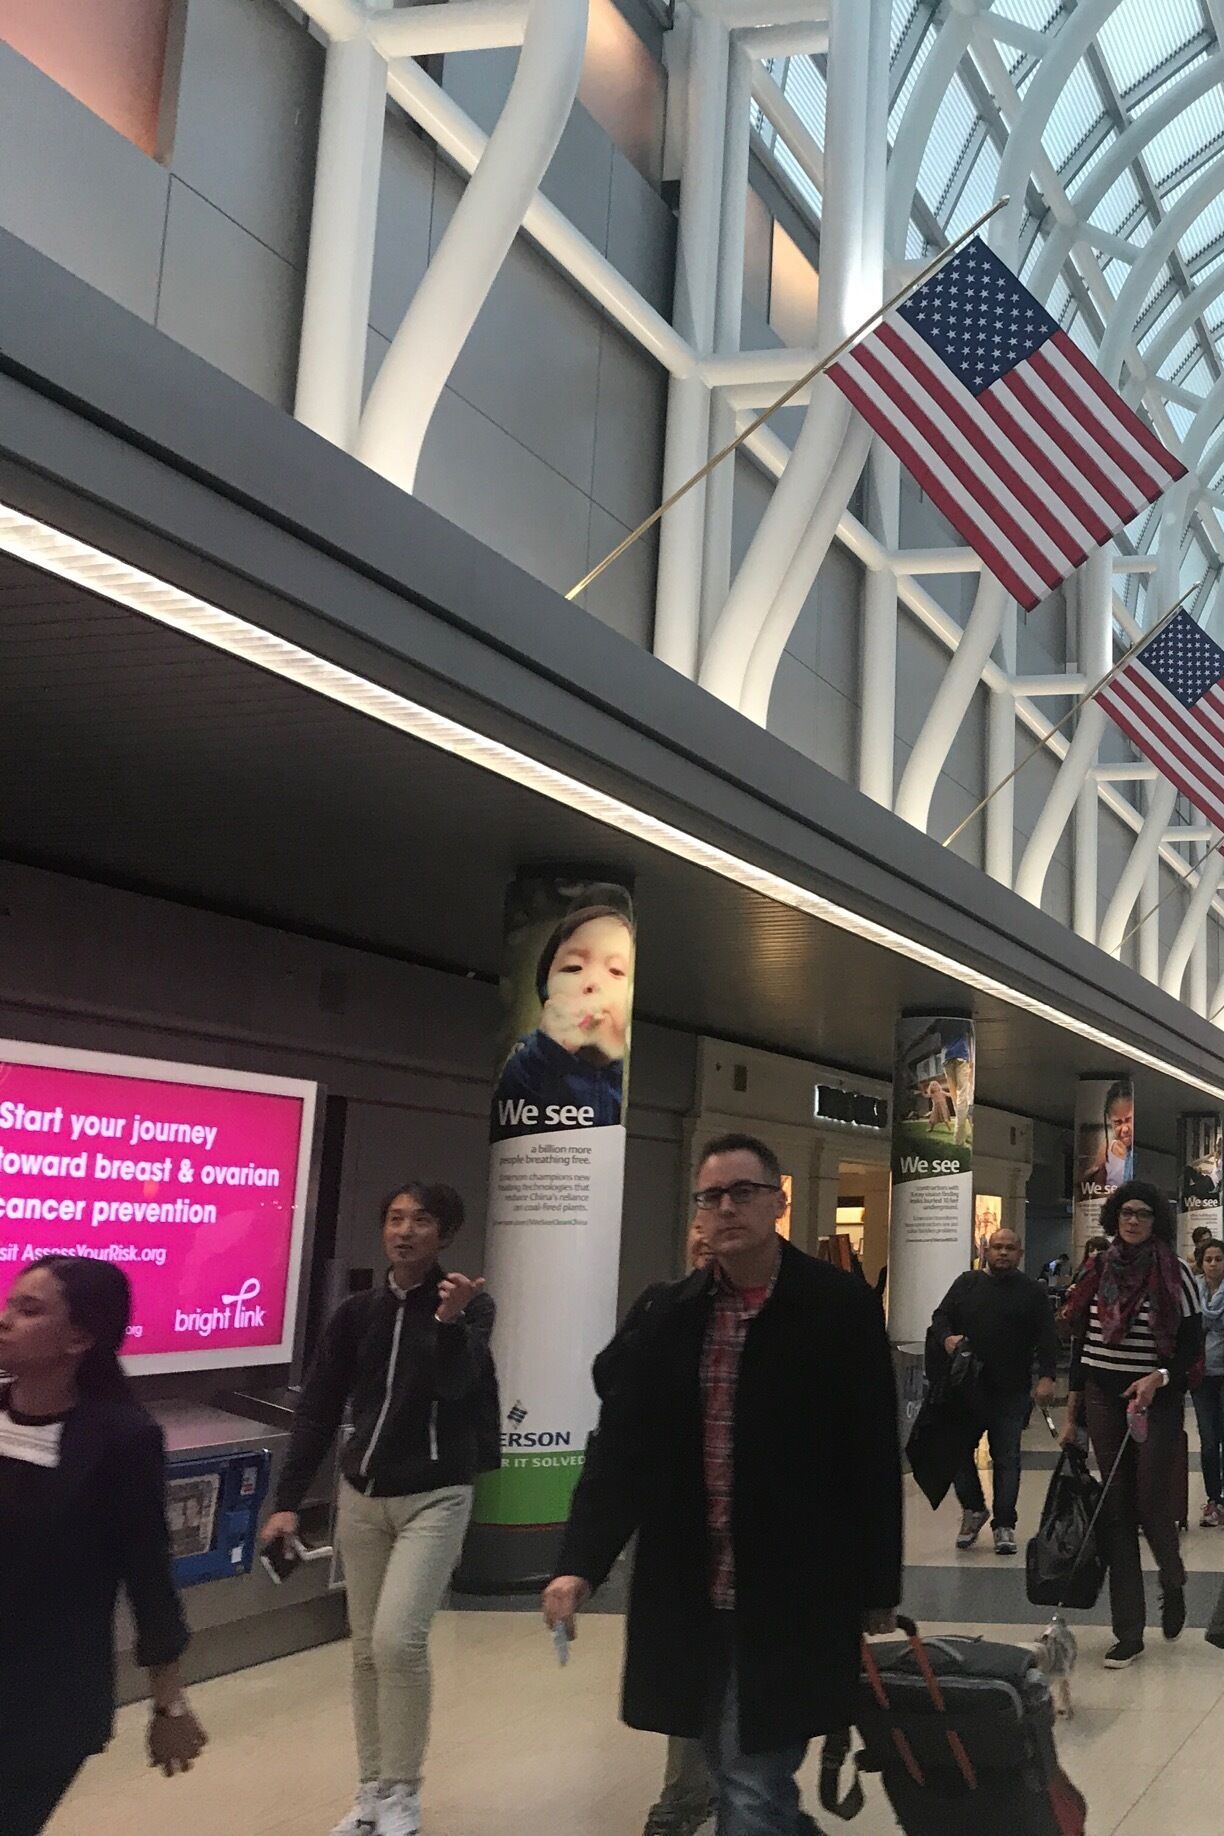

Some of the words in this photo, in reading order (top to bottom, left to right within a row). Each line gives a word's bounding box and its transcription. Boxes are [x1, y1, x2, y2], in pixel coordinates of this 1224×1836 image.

[497, 1098, 539, 1126] We
[544, 1104, 595, 1126] see
[0, 1101, 64, 1133] Start
[71, 1114, 127, 1141] your
[129, 1114, 218, 1151] journey
[538, 1144, 567, 1154] billion
[568, 1146, 592, 1154] more
[525, 1155, 570, 1166] breathing
[900, 1156, 929, 1174] We
[931, 1159, 960, 1173] see
[94, 1153, 172, 1182] breast
[177, 1158, 195, 1184] &
[201, 1162, 280, 1187] ovarian
[1080, 1181, 1104, 1195] We
[1104, 1184, 1118, 1195] se
[1184, 1197, 1201, 1207] We
[1203, 1198, 1218, 1207] see
[91, 1198, 217, 1227] prevention
[174, 1308, 232, 1337] bright
[513, 1458, 529, 1468] IT
[532, 1455, 586, 1468] SOLVED
